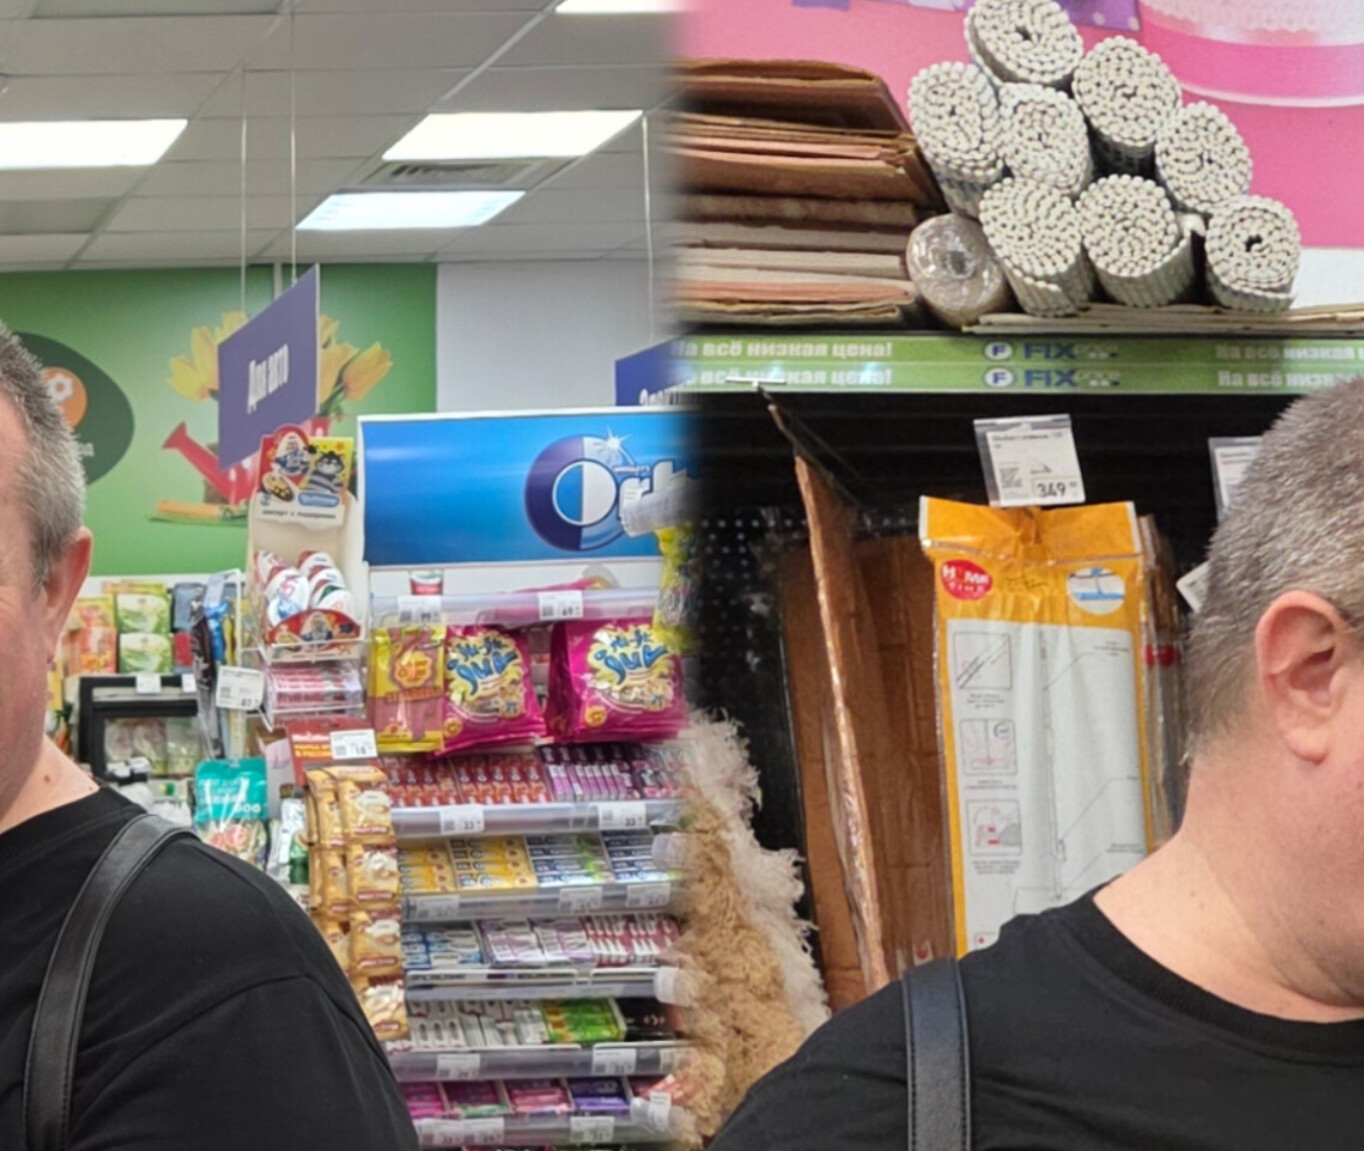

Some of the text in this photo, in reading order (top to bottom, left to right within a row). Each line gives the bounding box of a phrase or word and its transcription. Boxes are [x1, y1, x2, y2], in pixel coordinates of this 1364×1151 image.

[746, 342, 828, 357] низкая
[832, 341, 893, 359] цена!
[1036, 481, 1066, 499] 349
